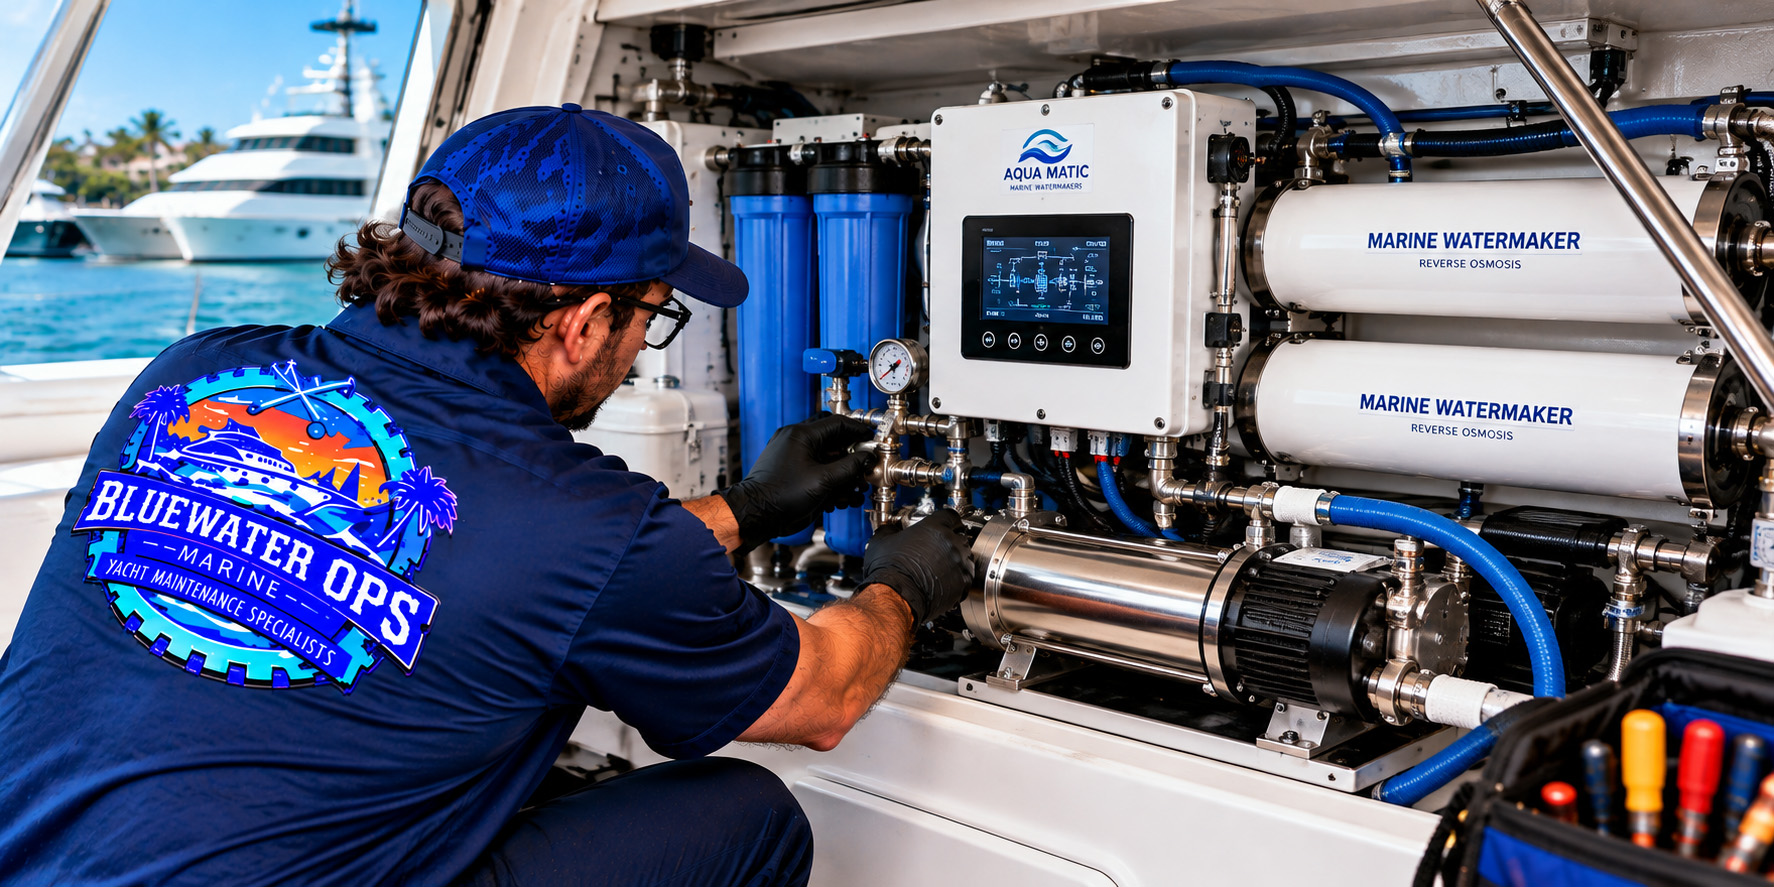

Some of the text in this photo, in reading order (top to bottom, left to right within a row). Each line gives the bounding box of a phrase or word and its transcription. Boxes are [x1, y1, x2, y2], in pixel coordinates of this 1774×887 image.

[1003, 164, 1090, 182] AQUA MATIC
[1367, 231, 1581, 250] MARINE WATERMAKER
[1419, 258, 1522, 270] REVERSE OSMOSIS
[1359, 393, 1573, 426] MARINE WATERMAKER
[1411, 423, 1514, 441] REVERSE OSMOSIS
[85, 480, 419, 646] BLUEWATER OPS
[178, 544, 280, 599] MARINE
[105, 558, 337, 667] YACHT MAINTENANCE SPECIALISTS
